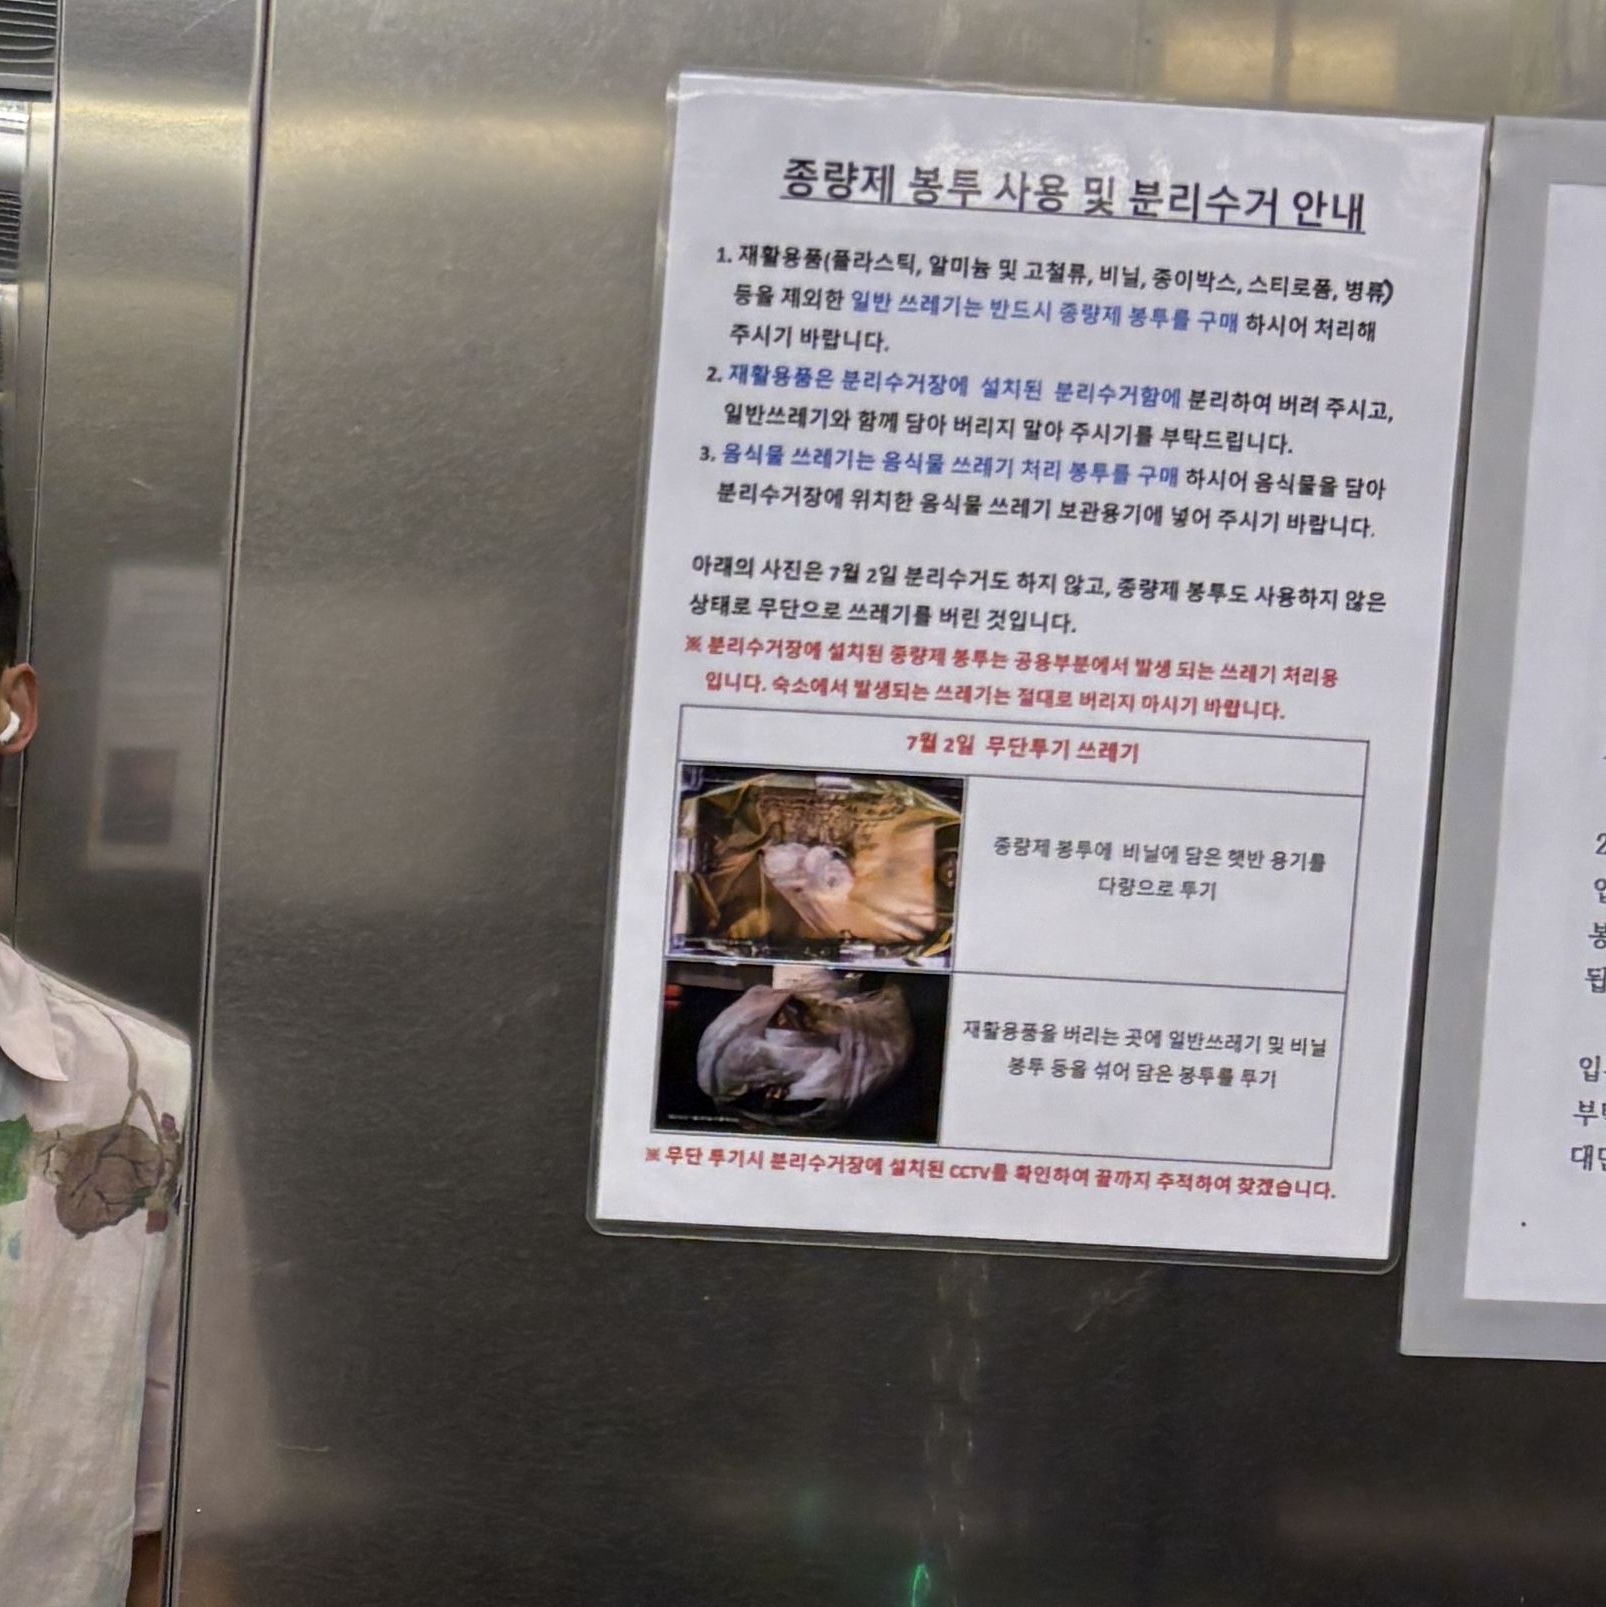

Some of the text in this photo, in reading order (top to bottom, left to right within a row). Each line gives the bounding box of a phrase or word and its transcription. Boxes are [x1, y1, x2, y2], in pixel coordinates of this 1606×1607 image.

[784, 158, 1365, 232] 종량제 봉투 사용 및 분리수거 안내
[717, 248, 732, 263] 1.
[929, 254, 991, 279] 알미늄
[998, 259, 1018, 281] 및
[1023, 261, 1093, 287] 고철류,
[1100, 265, 1146, 290] 비닐,
[1152, 267, 1243, 296] 종이박스,
[1248, 275, 1338, 301] 스티로폼,
[1345, 278, 1395, 306] 병류)
[734, 283, 1377, 342] 등을 제외한 일반 쓰레기는 반드시 종량제 봉투를 구매 하시어 처리해
[730, 324, 890, 353] 주시기 바랍니다.
[707, 364, 1394, 424] 2. 재활용품은 분리수거장에 설치된 분리수거함에 분리하여 버려 주시고,
[724, 402, 1293, 455] 일반쓰레기와 함께 담아 버리지 말아 주시기를 부탁드립니다.
[722, 443, 784, 467] 음식물
[791, 446, 875, 472] 쓰레기는
[882, 450, 944, 475] 음식물
[951, 454, 1013, 479] 쓰레기
[1021, 459, 1061, 482] 처리
[1068, 461, 1130, 485] 봉투를
[1137, 465, 1179, 488] 구매
[1186, 467, 1248, 492] 하시어
[1254, 471, 1338, 497] 음식물을
[1345, 477, 1386, 501] 담아
[717, 482, 1375, 539] 분리수거장에 위치한 음식물 쓰레기 보관용기에 넣어 주시기 바랍니다.
[693, 554, 1386, 613] 아래의 사진은 7월 2일 분리수거도 하지 않고, 종량제 봉투도 사용하지 않은
[689, 593, 1077, 635] 상태로 무단으로 쓰레기를 버린 것입니다.
[708, 636, 821, 661] 분리수거장에
[828, 641, 884, 664] 설치된
[890, 644, 946, 667] 종량제
[952, 648, 1008, 669] 봉투는
[1015, 650, 1129, 677] 공용부분에서
[1135, 657, 1171, 679] 발생
[1176, 661, 1215, 682] 되는
[1220, 662, 1276, 684] 쓰레기
[1283, 665, 1339, 688] 처리용
[705, 671, 1286, 722] 입니다. 숙소에서 발생되는 쓰레기는 절대로 버리지 마시기 바랍니다.
[907, 731, 1139, 765] 7월 2일 무단투기 쓰레기
[994, 836, 1326, 873] 종량제 봉투에 비닐에 담은 햇반 용기를
[1099, 876, 1217, 901] 다량으로 투기
[1063, 1025, 1120, 1047] 버리는
[1125, 1028, 1162, 1050] 곳에
[1169, 1030, 1261, 1054] 일반쓰레기
[1268, 1036, 1284, 1056] 및
[1291, 1037, 1326, 1057] 비닐
[1007, 1056, 1277, 1089] 봉투 등을 섞어 담은 봉투를 투기
[1579, 1055, 1606, 1082] 입
[1573, 1100, 1606, 1126] 부
[665, 1147, 702, 1166] 무단
[709, 1149, 763, 1169] 투기시
[770, 1152, 882, 1177] 분리수거장에
[889, 1159, 943, 1179] 설치된
[949, 1164, 1007, 1181] CCTV를
[1014, 1164, 1089, 1187] 확인하여
[1095, 1169, 1151, 1190] 끝까지
[1157, 1171, 1231, 1194] 추적하여
[1237, 1177, 1336, 1200] 찾겠습니다.
